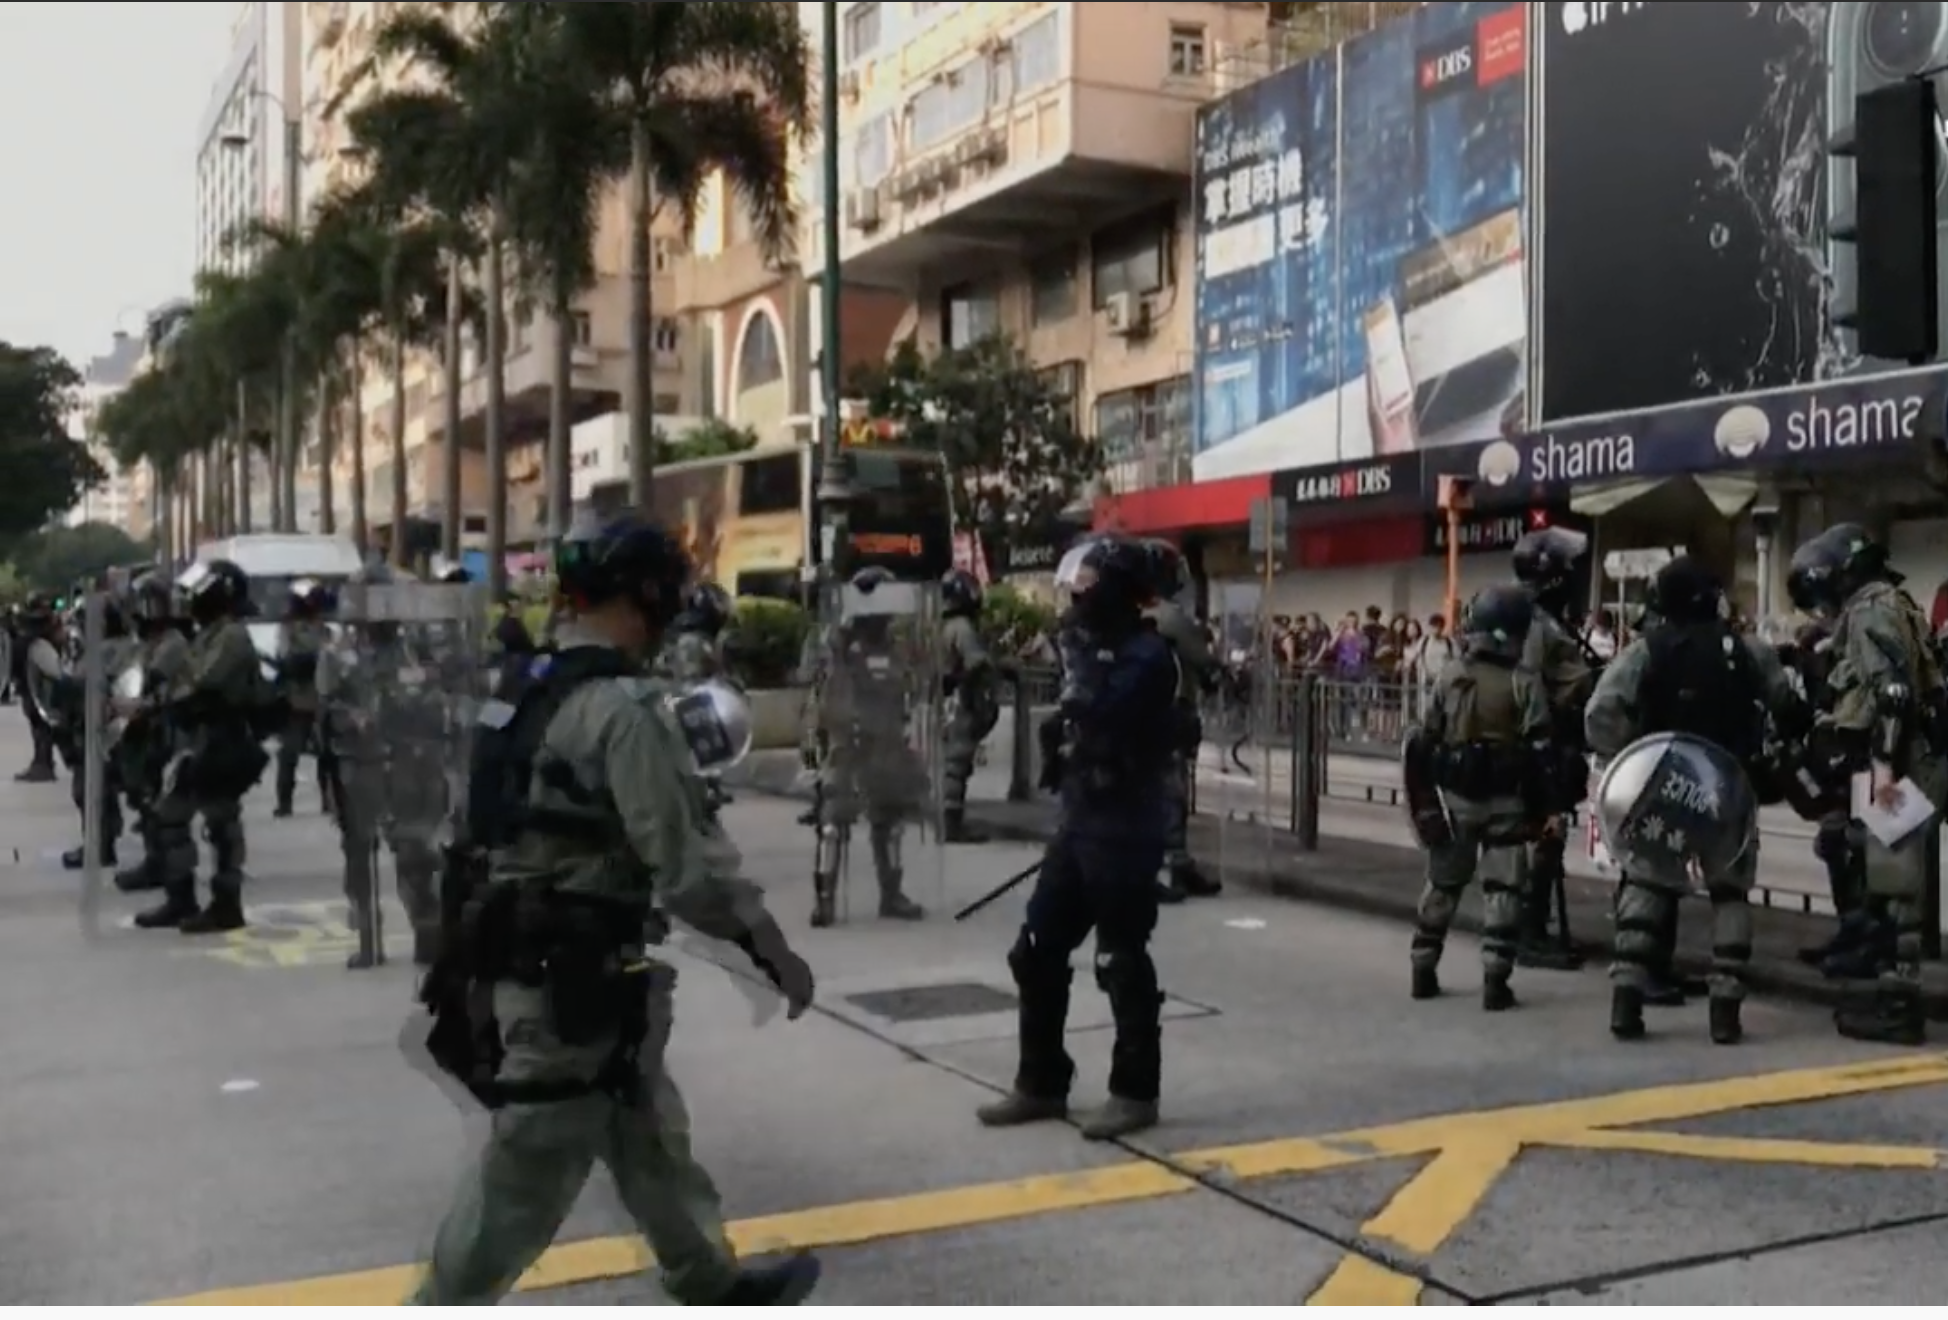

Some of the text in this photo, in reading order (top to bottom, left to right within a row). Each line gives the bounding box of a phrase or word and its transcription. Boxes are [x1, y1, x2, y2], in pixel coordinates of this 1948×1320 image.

[1437, 45, 1471, 81] DBS
[1531, 434, 1635, 482] shama
[1356, 464, 1392, 496] DBS
